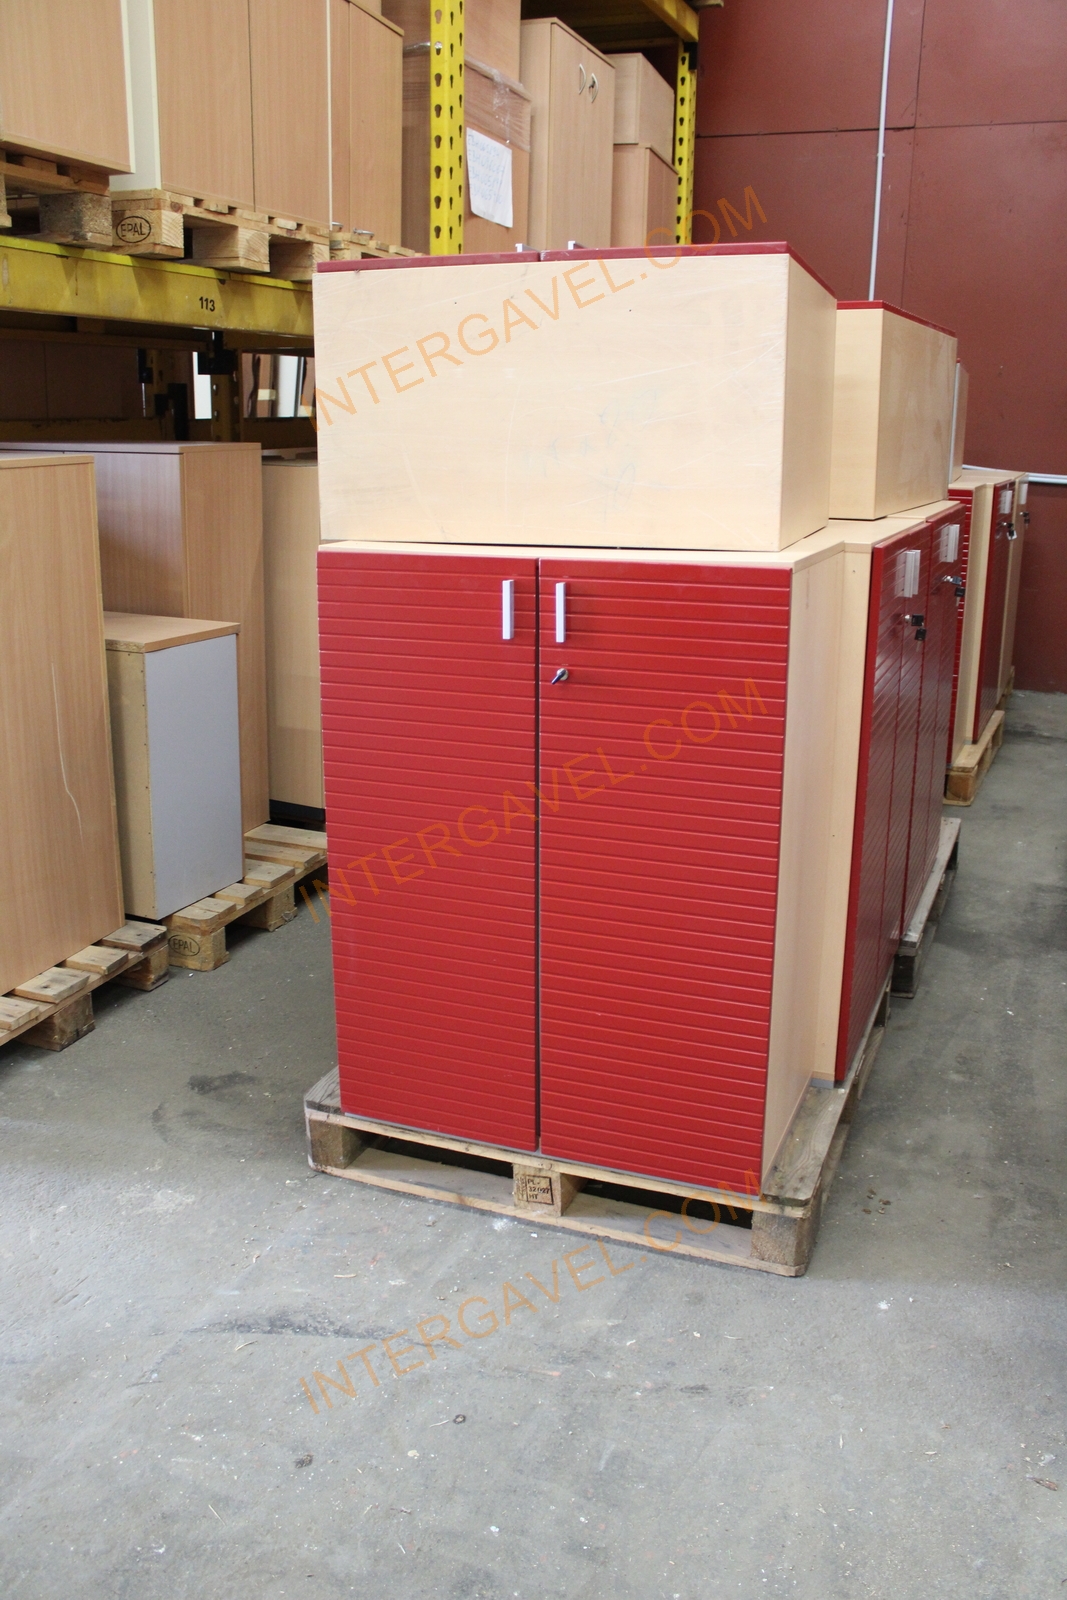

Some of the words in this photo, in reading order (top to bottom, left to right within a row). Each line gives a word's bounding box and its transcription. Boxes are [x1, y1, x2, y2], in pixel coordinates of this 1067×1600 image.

[119, 219, 146, 238] EPAL
[198, 296, 216, 312] 113
[173, 938, 196, 954] EPAL
